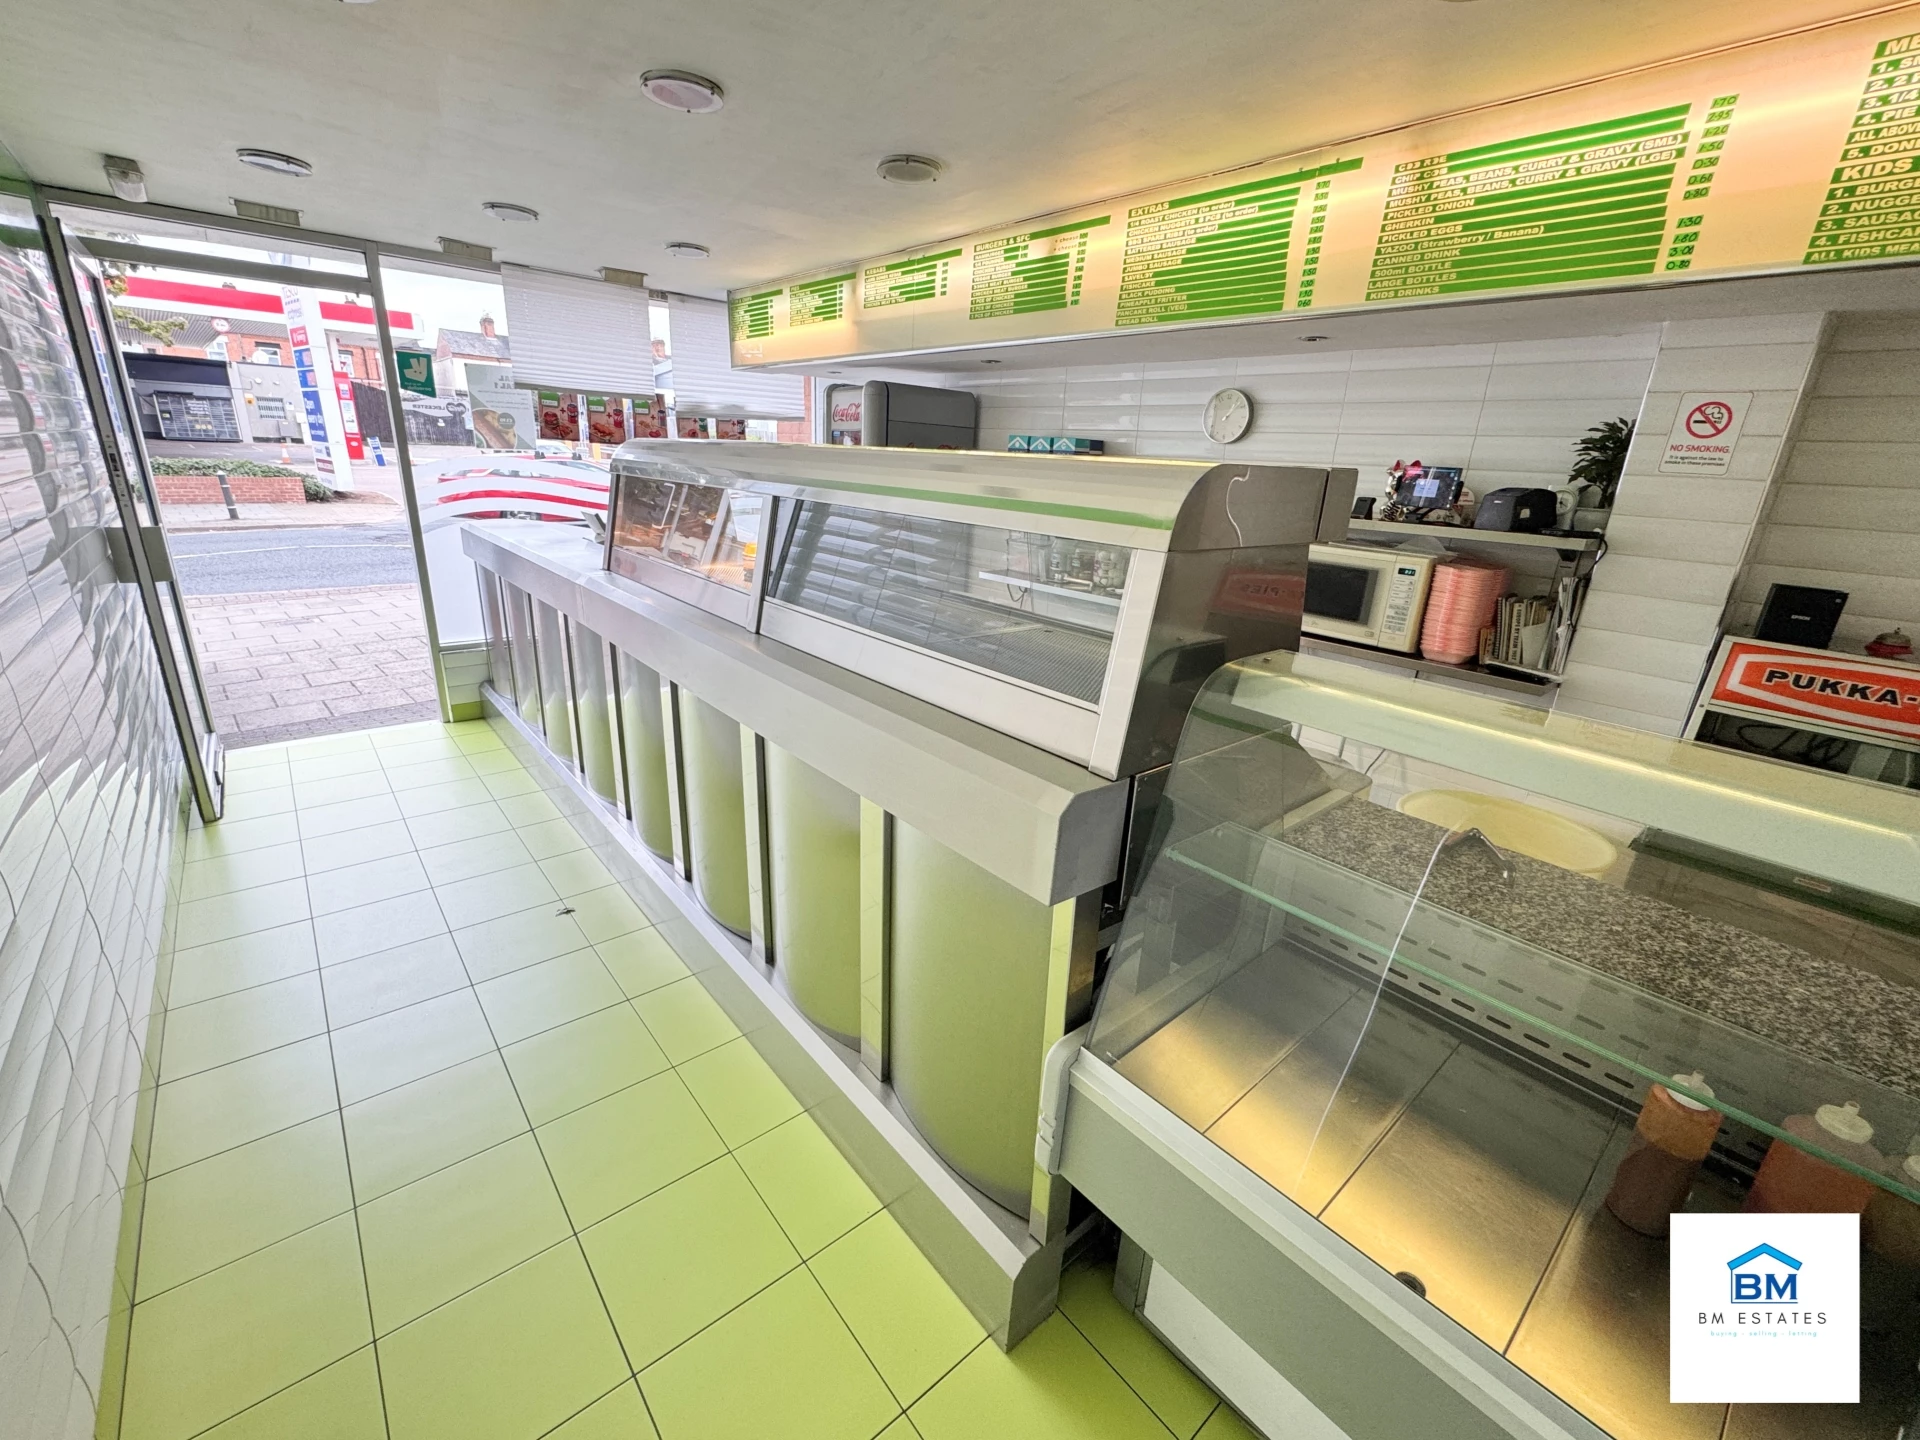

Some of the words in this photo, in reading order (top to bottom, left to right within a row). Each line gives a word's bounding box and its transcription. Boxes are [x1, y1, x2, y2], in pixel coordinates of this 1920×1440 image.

[1877, 63, 1894, 73] 1.
[1887, 90, 1919, 104] 1/4
[1881, 106, 1918, 122] PIE
[1851, 131, 1876, 142] ALL
[1391, 182, 1429, 197] MUSHY
[1432, 175, 1467, 189] PEAS,
[1469, 165, 1515, 182] BEANS,
[1518, 156, 1565, 173] CURRY
[1568, 153, 1581, 164] &
[1583, 142, 1635, 161] GRAVY
[1637, 133, 1683, 151] (SML)
[1841, 158, 1913, 181] KIDS
[1388, 194, 1427, 209] MUSHY
[1429, 187, 1464, 201] PEAS,
[1466, 179, 1512, 195] BEANS,
[1515, 170, 1562, 186] CURRY
[1565, 167, 1577, 177] &
[1579, 157, 1632, 175] GRAVY
[1634, 149, 1676, 165] (LGE)
[1394, 172, 1420, 183] CHIP
[1423, 166, 1448, 178] COB
[1833, 188, 1849, 198] 1.
[1130, 201, 1170, 217] EXTRAS
[1140, 215, 1163, 225] ROAST
[1164, 207, 1198, 220] CHICKEN
[1210, 200, 1235, 211] order)
[1386, 205, 1432, 219] PICKLED
[1435, 198, 1475, 211] ONION
[1826, 205, 1843, 215] 2.
[1384, 217, 1434, 231] GHERKIN
[1821, 221, 1837, 231] 3.
[1379, 243, 1415, 255] YAZOO
[1417, 233, 1485, 250] (Strawberry
[1492, 224, 1544, 239] Banana)
[1381, 229, 1427, 243] PICKLED
[1430, 224, 1463, 235] EGGS
[975, 238, 1007, 251] BURGERS
[1015, 233, 1030, 243] SFC
[1126, 244, 1161, 255] BATTERED
[1162, 237, 1196, 248] SAUSAGE
[1814, 237, 1831, 246] 4.
[1125, 254, 1152, 263] MEDIUM
[1153, 248, 1186, 259] SAUSAGE
[1376, 254, 1421, 265] CANNED
[1423, 248, 1461, 259] DRINK
[1810, 251, 1837, 262] ALL
[1842, 246, 1881, 258] KIDS
[1124, 264, 1147, 272] JUMBO
[1149, 258, 1182, 268] SAUSAGE
[1374, 267, 1405, 277] 500ml
[1407, 261, 1452, 273] BOTTLE
[1123, 272, 1153, 281] SAVELOY
[1368, 278, 1403, 288] LARGE
[1405, 272, 1457, 284] BOTTLES
[1122, 280, 1155, 290] FISHCAKE
[1143, 286, 1175, 296] PUDDING
[1369, 291, 1395, 299] KIDS
[1397, 286, 1439, 297] DRINKS
[1119, 298, 1155, 307] PINEAPPLE
[1157, 294, 1187, 303] FRITTER
[1117, 308, 1147, 316] PANCAKE
[1167, 303, 1188, 311] (VEG)
[1670, 444, 1683, 452] NO
